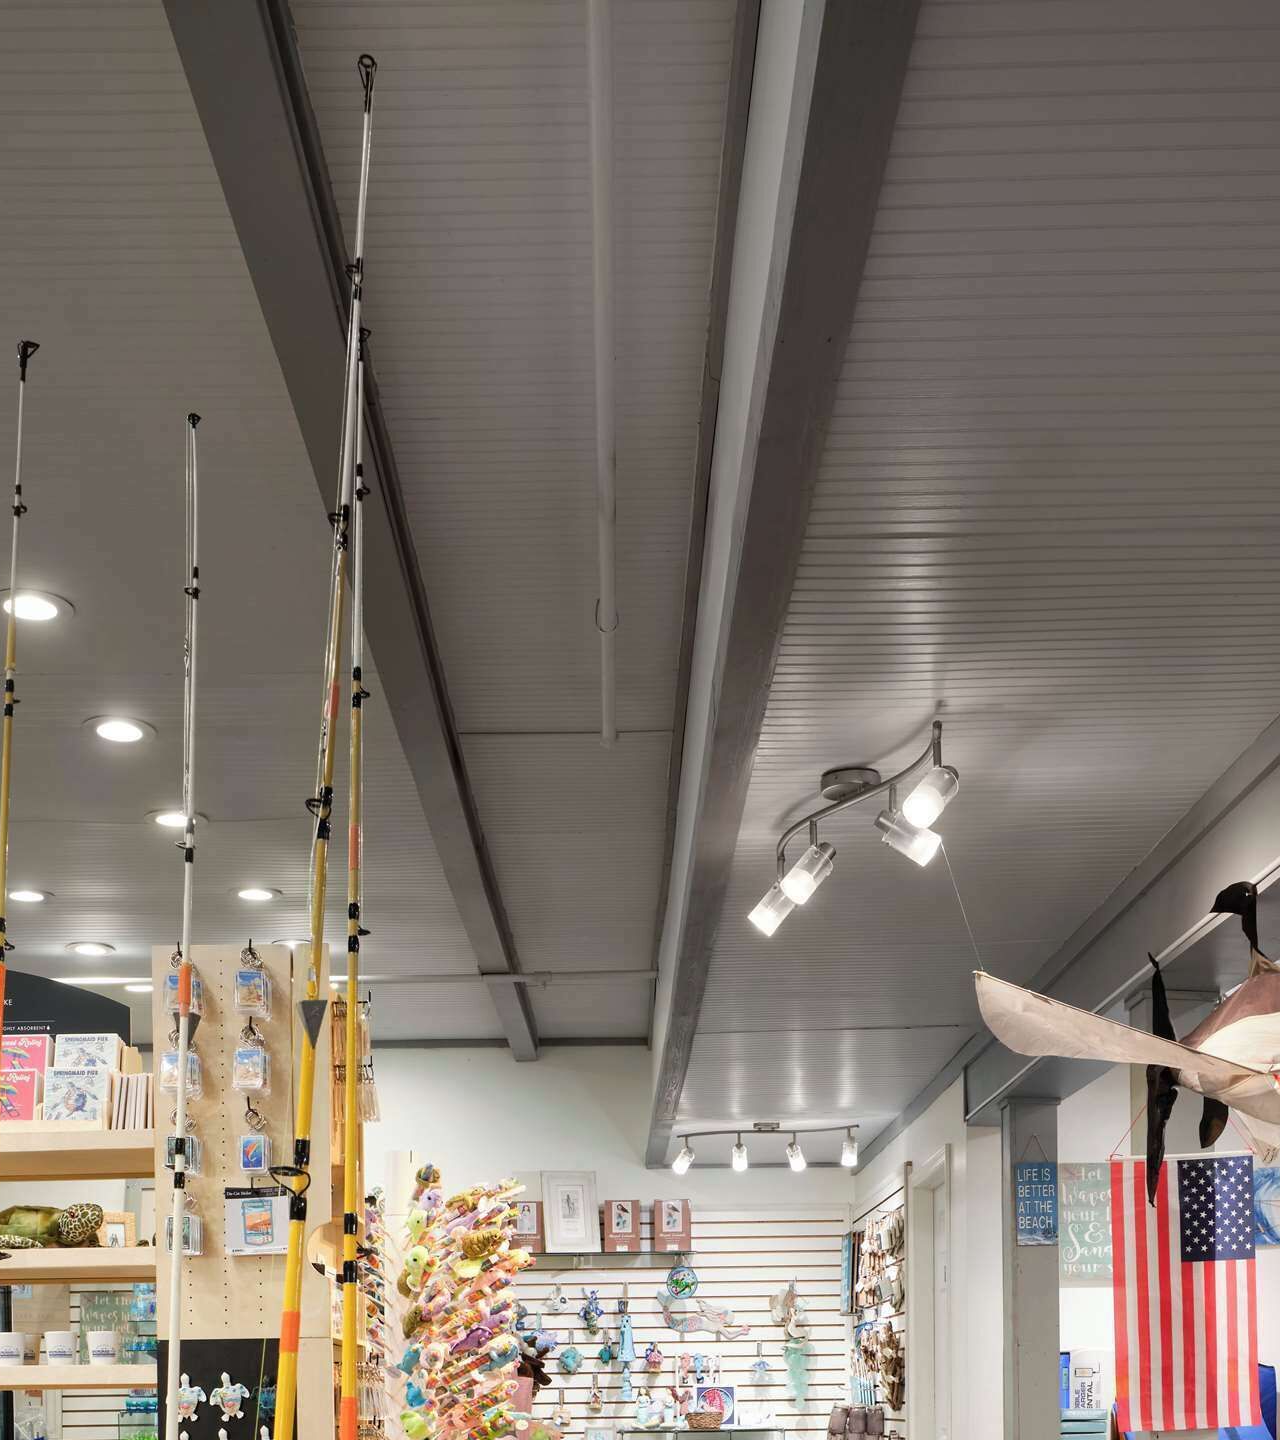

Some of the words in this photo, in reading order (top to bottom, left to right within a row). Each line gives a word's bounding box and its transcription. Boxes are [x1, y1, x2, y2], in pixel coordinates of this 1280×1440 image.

[1017, 1168, 1038, 1181] LIFE
[1041, 1168, 1051, 1181] IS
[1081, 1167, 1103, 1181] Let
[1018, 1184, 1055, 1198] BETTER
[1018, 1201, 1031, 1214] AT
[1034, 1200, 1053, 1213] THE
[1018, 1215, 1053, 1229] BEACH
[1084, 1222, 1106, 1243] &
